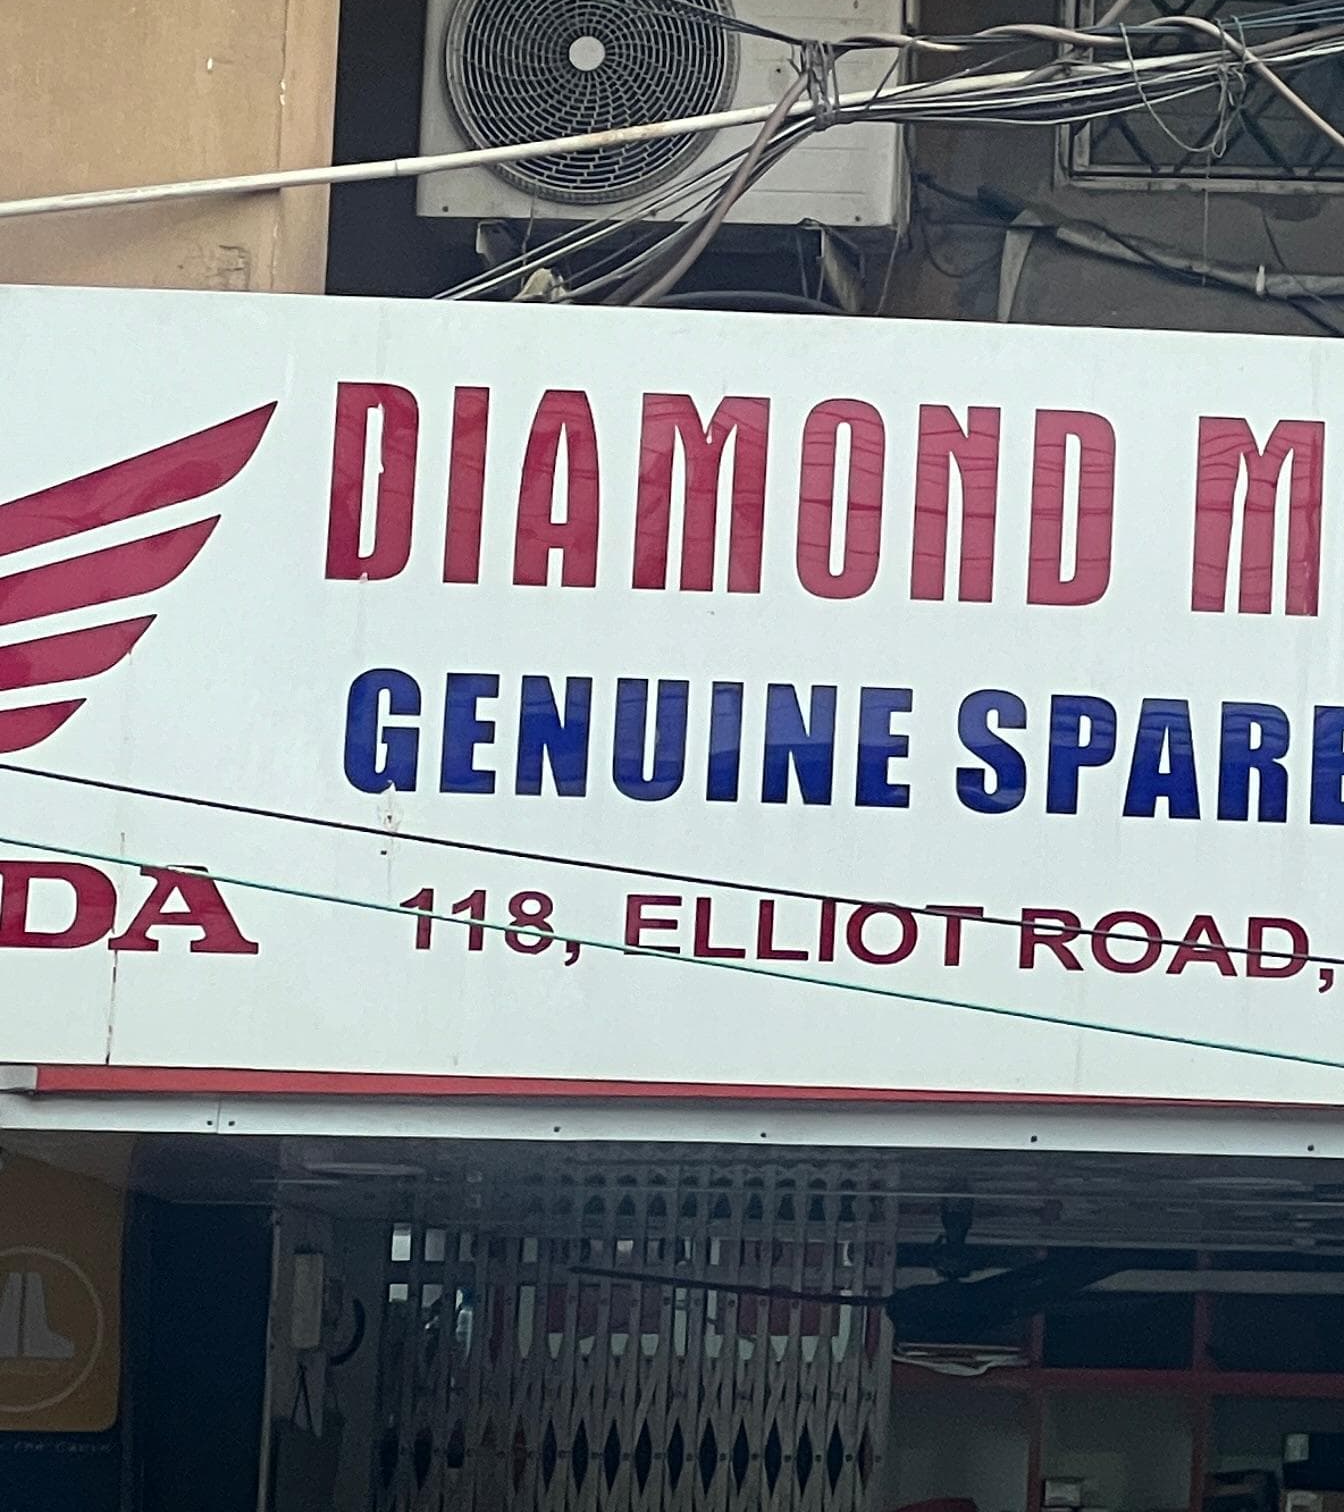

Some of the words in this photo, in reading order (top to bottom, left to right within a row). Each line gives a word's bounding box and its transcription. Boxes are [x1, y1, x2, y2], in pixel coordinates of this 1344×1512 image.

[325, 381, 1117, 607] DIAMOND
[343, 668, 914, 809] GENUINE
[400, 888, 583, 966] 118,
[623, 893, 985, 967] ELLIOT
[1018, 907, 1335, 993] ROAD,
